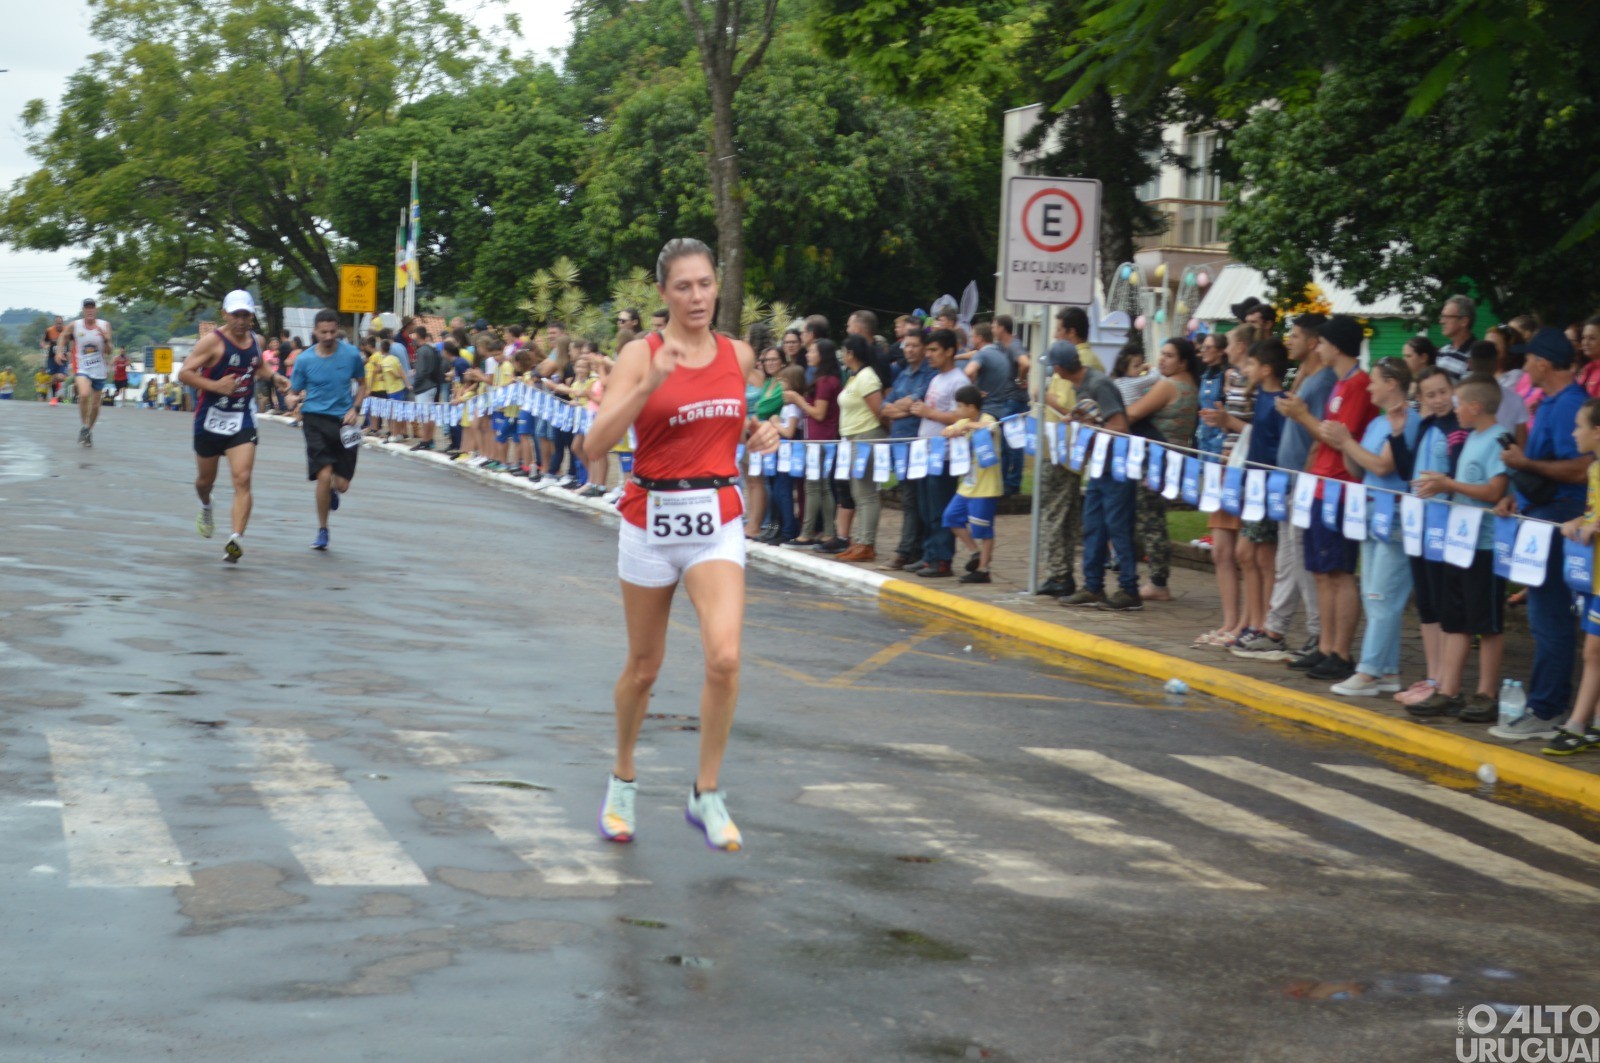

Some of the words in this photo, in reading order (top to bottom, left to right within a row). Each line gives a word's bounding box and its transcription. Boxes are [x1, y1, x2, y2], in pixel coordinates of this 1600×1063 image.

[1043, 203, 1062, 236] E
[1012, 260, 1088, 275] EXCLUSIVO
[669, 405, 741, 427] FLORENAL
[653, 512, 714, 537] 538
